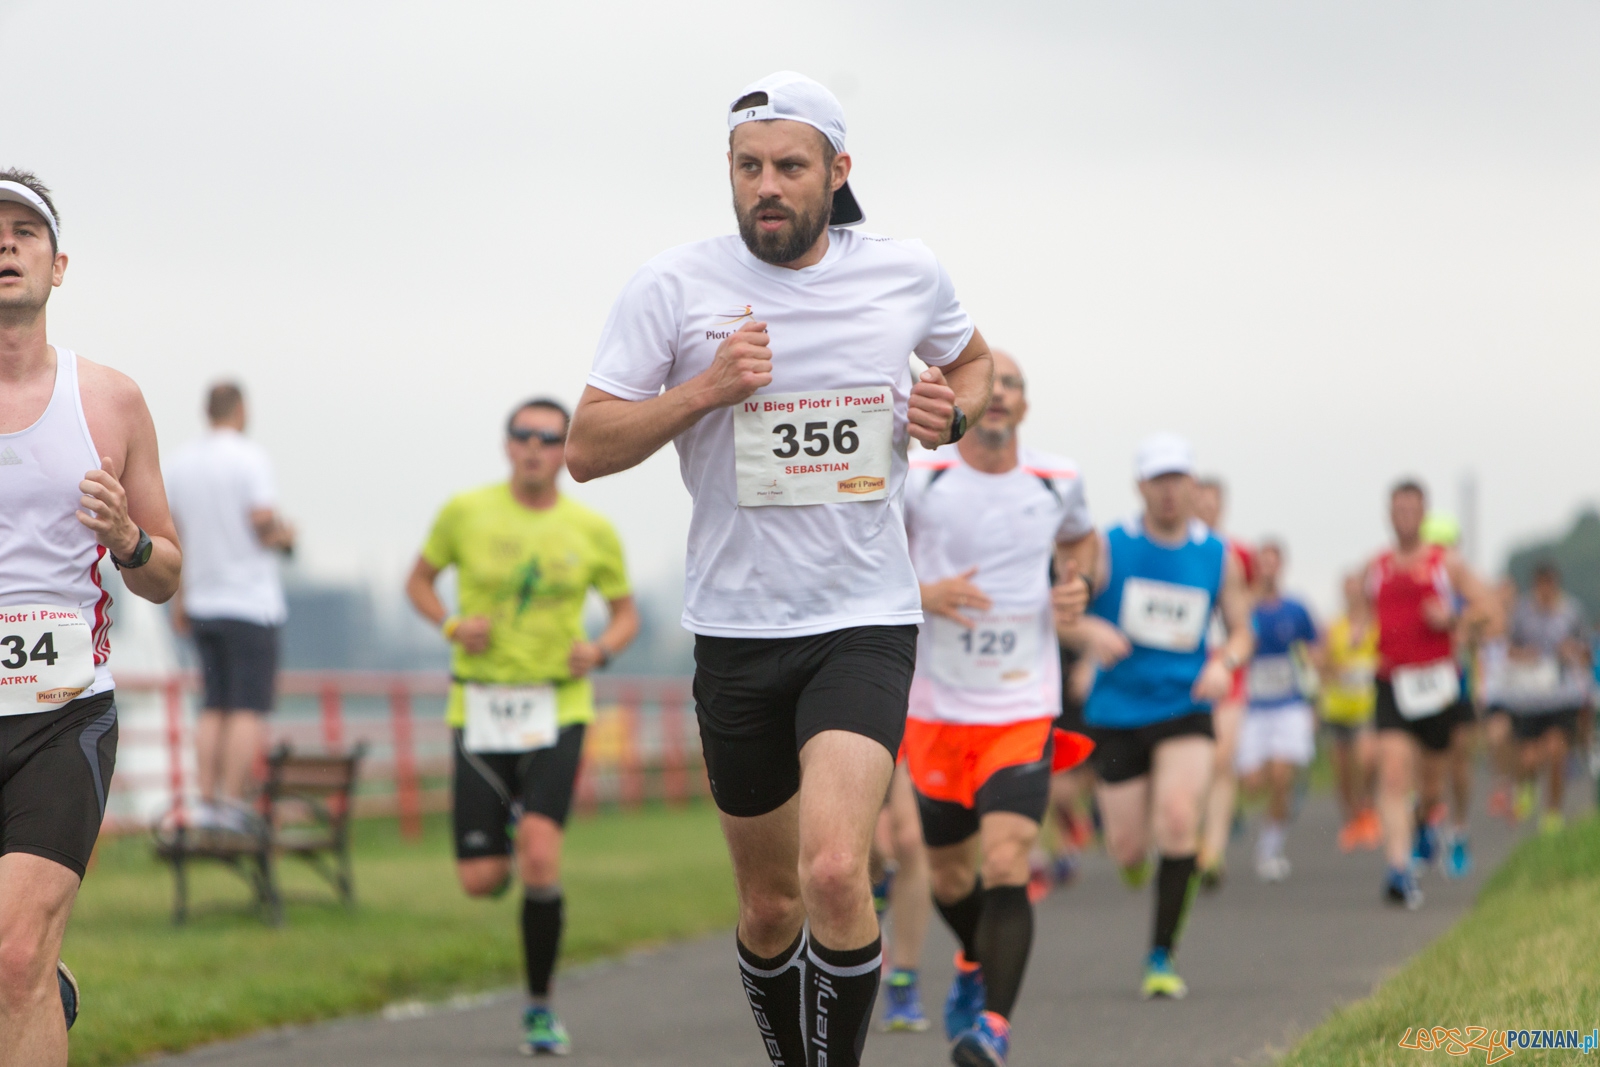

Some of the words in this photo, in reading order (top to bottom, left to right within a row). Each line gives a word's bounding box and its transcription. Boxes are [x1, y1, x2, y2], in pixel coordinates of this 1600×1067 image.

[705, 330, 730, 340] Piotr
[744, 402, 759, 413] IV
[763, 400, 795, 413] Bieg
[799, 398, 832, 410] Piotr
[836, 396, 840, 407] i
[844, 393, 885, 406] Paweł
[771, 419, 860, 459] 356
[785, 462, 849, 475] SEBASTIAN
[863, 479, 884, 487] Paweł
[32, 611, 36, 621] i
[959, 629, 1017, 655] 129
[0, 632, 58, 669] 34
[0, 675, 38, 685] ATRYK
[38, 692, 57, 700] Piotr
